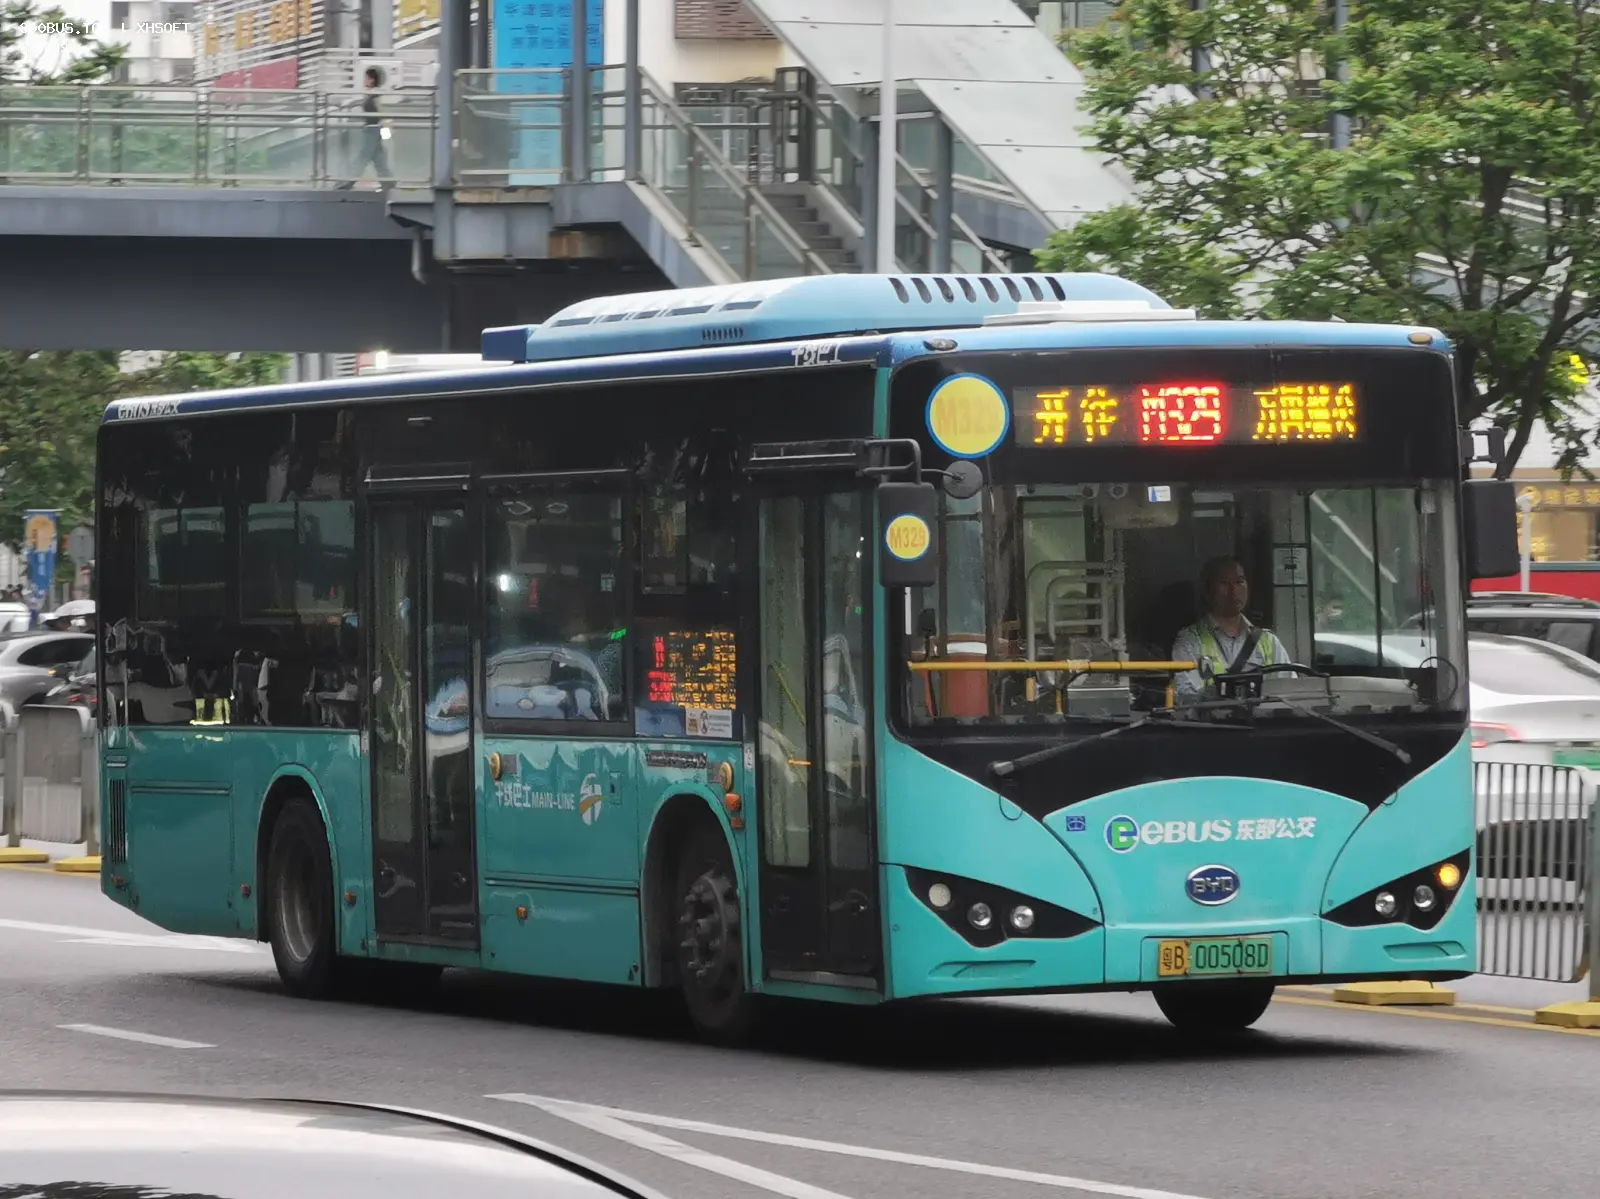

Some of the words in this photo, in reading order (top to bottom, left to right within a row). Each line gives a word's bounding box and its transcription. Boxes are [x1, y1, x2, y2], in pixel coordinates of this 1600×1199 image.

[889, 525, 926, 549] M329
[1236, 816, 1318, 841] 东部公交
[1191, 876, 1233, 894] BYD
[1195, 943, 1269, 970] 00508D
